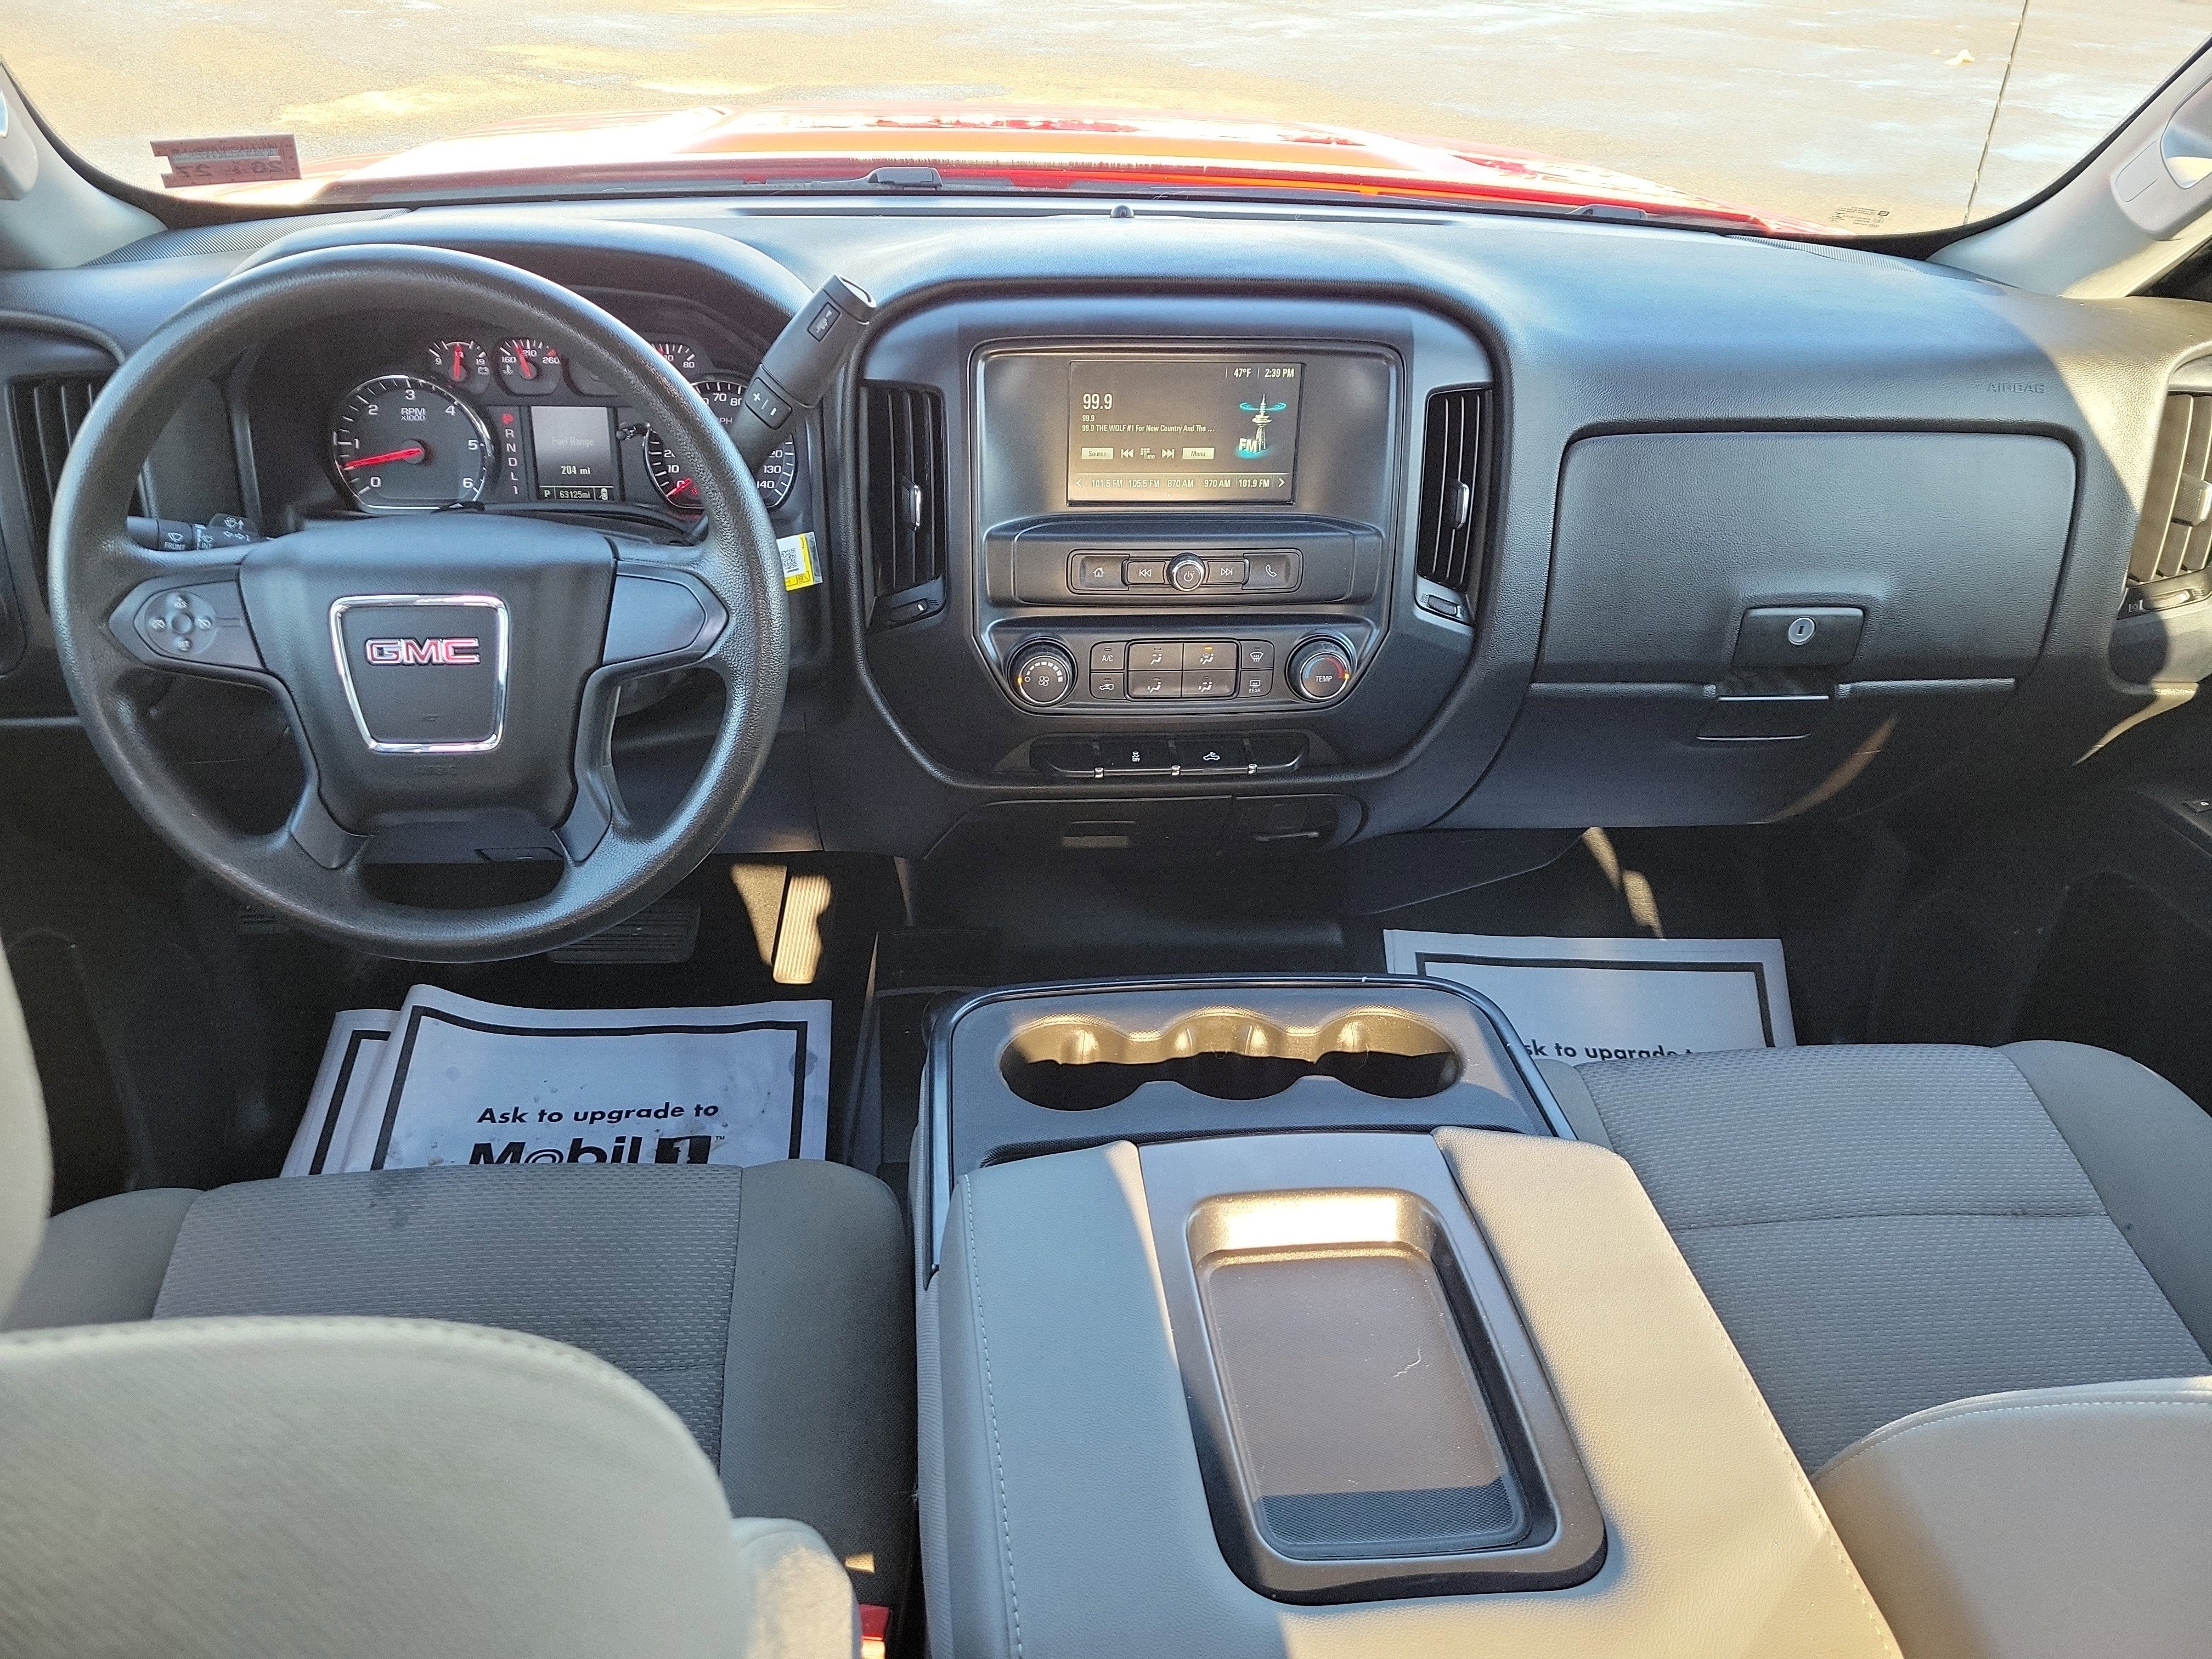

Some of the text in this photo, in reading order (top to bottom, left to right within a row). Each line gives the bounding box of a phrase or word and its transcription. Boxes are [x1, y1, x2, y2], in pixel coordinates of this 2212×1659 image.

[1233, 368, 1251, 378] 47°F
[1264, 368, 1295, 378] 2:39 PM
[1987, 382, 2046, 393] AIRBAG
[405, 389, 415, 400] 3
[713, 393, 727, 402] 70
[1082, 393, 1113, 410] 99.9
[368, 404, 379, 415] 2
[445, 405, 456, 416] 4
[505, 428, 515, 438] R
[1160, 425, 1182, 433] Country
[353, 438, 360, 449] 1
[468, 439, 478, 450] 5
[551, 437, 594, 448] Fuel Range
[1239, 438, 1259, 453] FM
[506, 443, 516, 453] N
[508, 457, 518, 466] D
[561, 465, 577, 475] 204
[667, 465, 680, 473] 10
[763, 465, 782, 473] 130
[510, 471, 519, 481] L
[370, 477, 381, 488] 0
[463, 477, 474, 489] 6
[757, 480, 775, 489] 140
[1092, 479, 1122, 488] 101.5 FM
[1128, 479, 1160, 488] 105.5 FM
[1167, 479, 1194, 488] 870 AM
[1204, 479, 1231, 488] 970 AM
[1239, 479, 1269, 488] 101.9 FM
[165, 541, 185, 550] FRONT
[365, 637, 481, 666] GMC
[1102, 654, 1113, 662] A/C
[1524, 1039, 1549, 1056] sk
[1554, 1042, 1577, 1057] to
[476, 1102, 719, 1125] Ask to upgrade to
